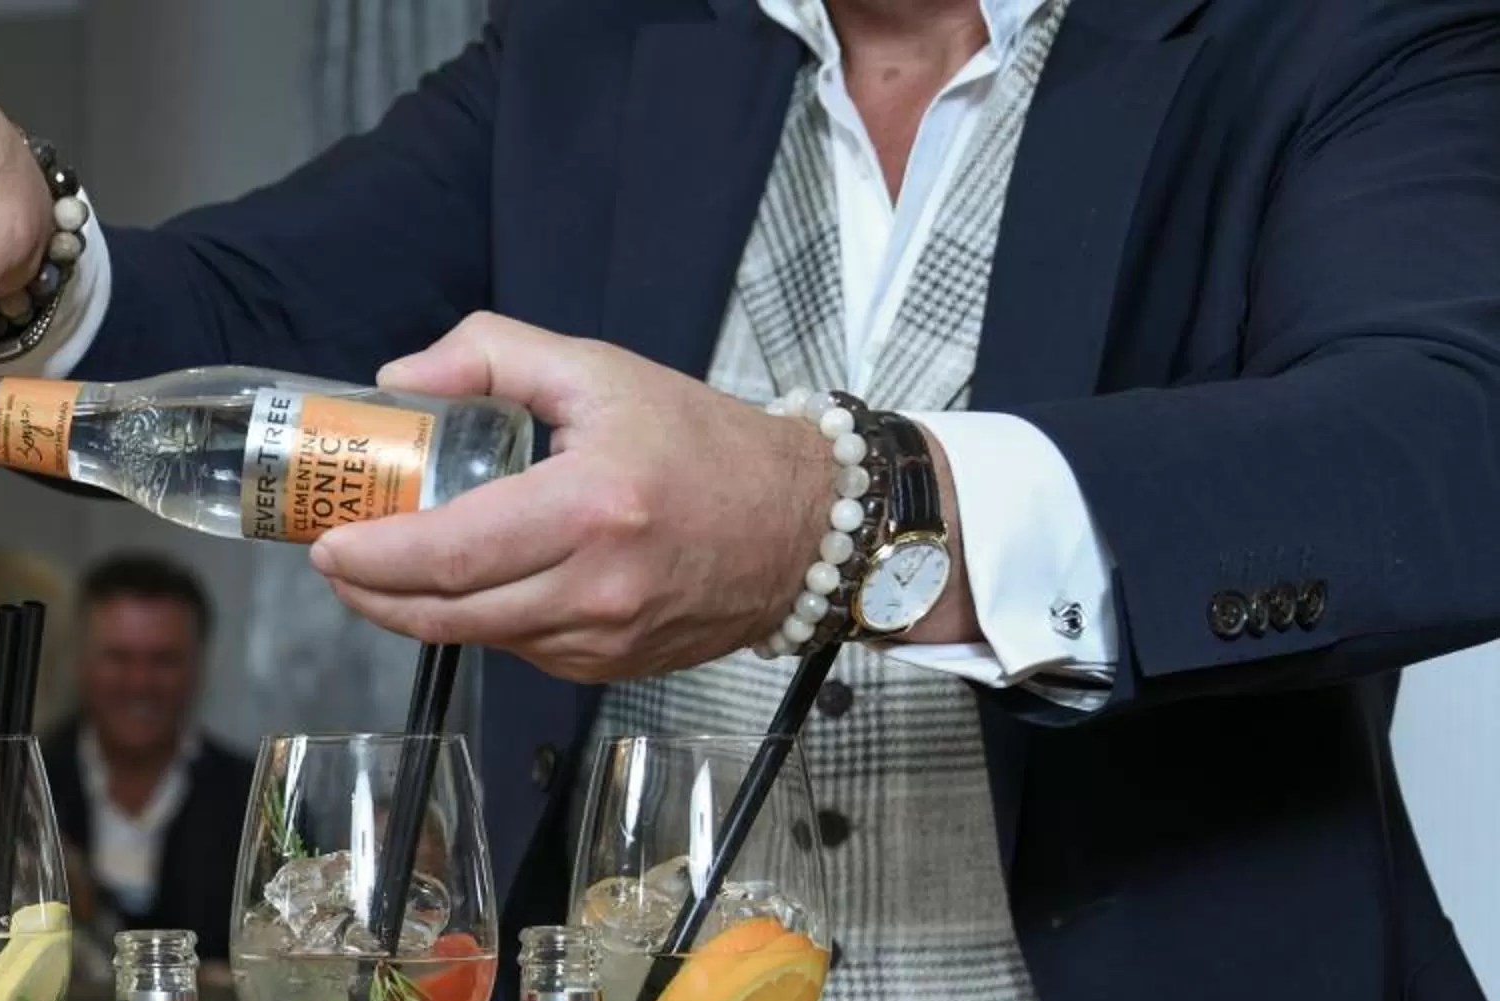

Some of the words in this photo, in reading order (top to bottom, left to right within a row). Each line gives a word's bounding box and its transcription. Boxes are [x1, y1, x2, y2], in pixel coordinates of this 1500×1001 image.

[253, 396, 291, 539] FEVER-TREE
[293, 426, 318, 532] CLEMENTINE
[311, 436, 342, 531] TONIC
